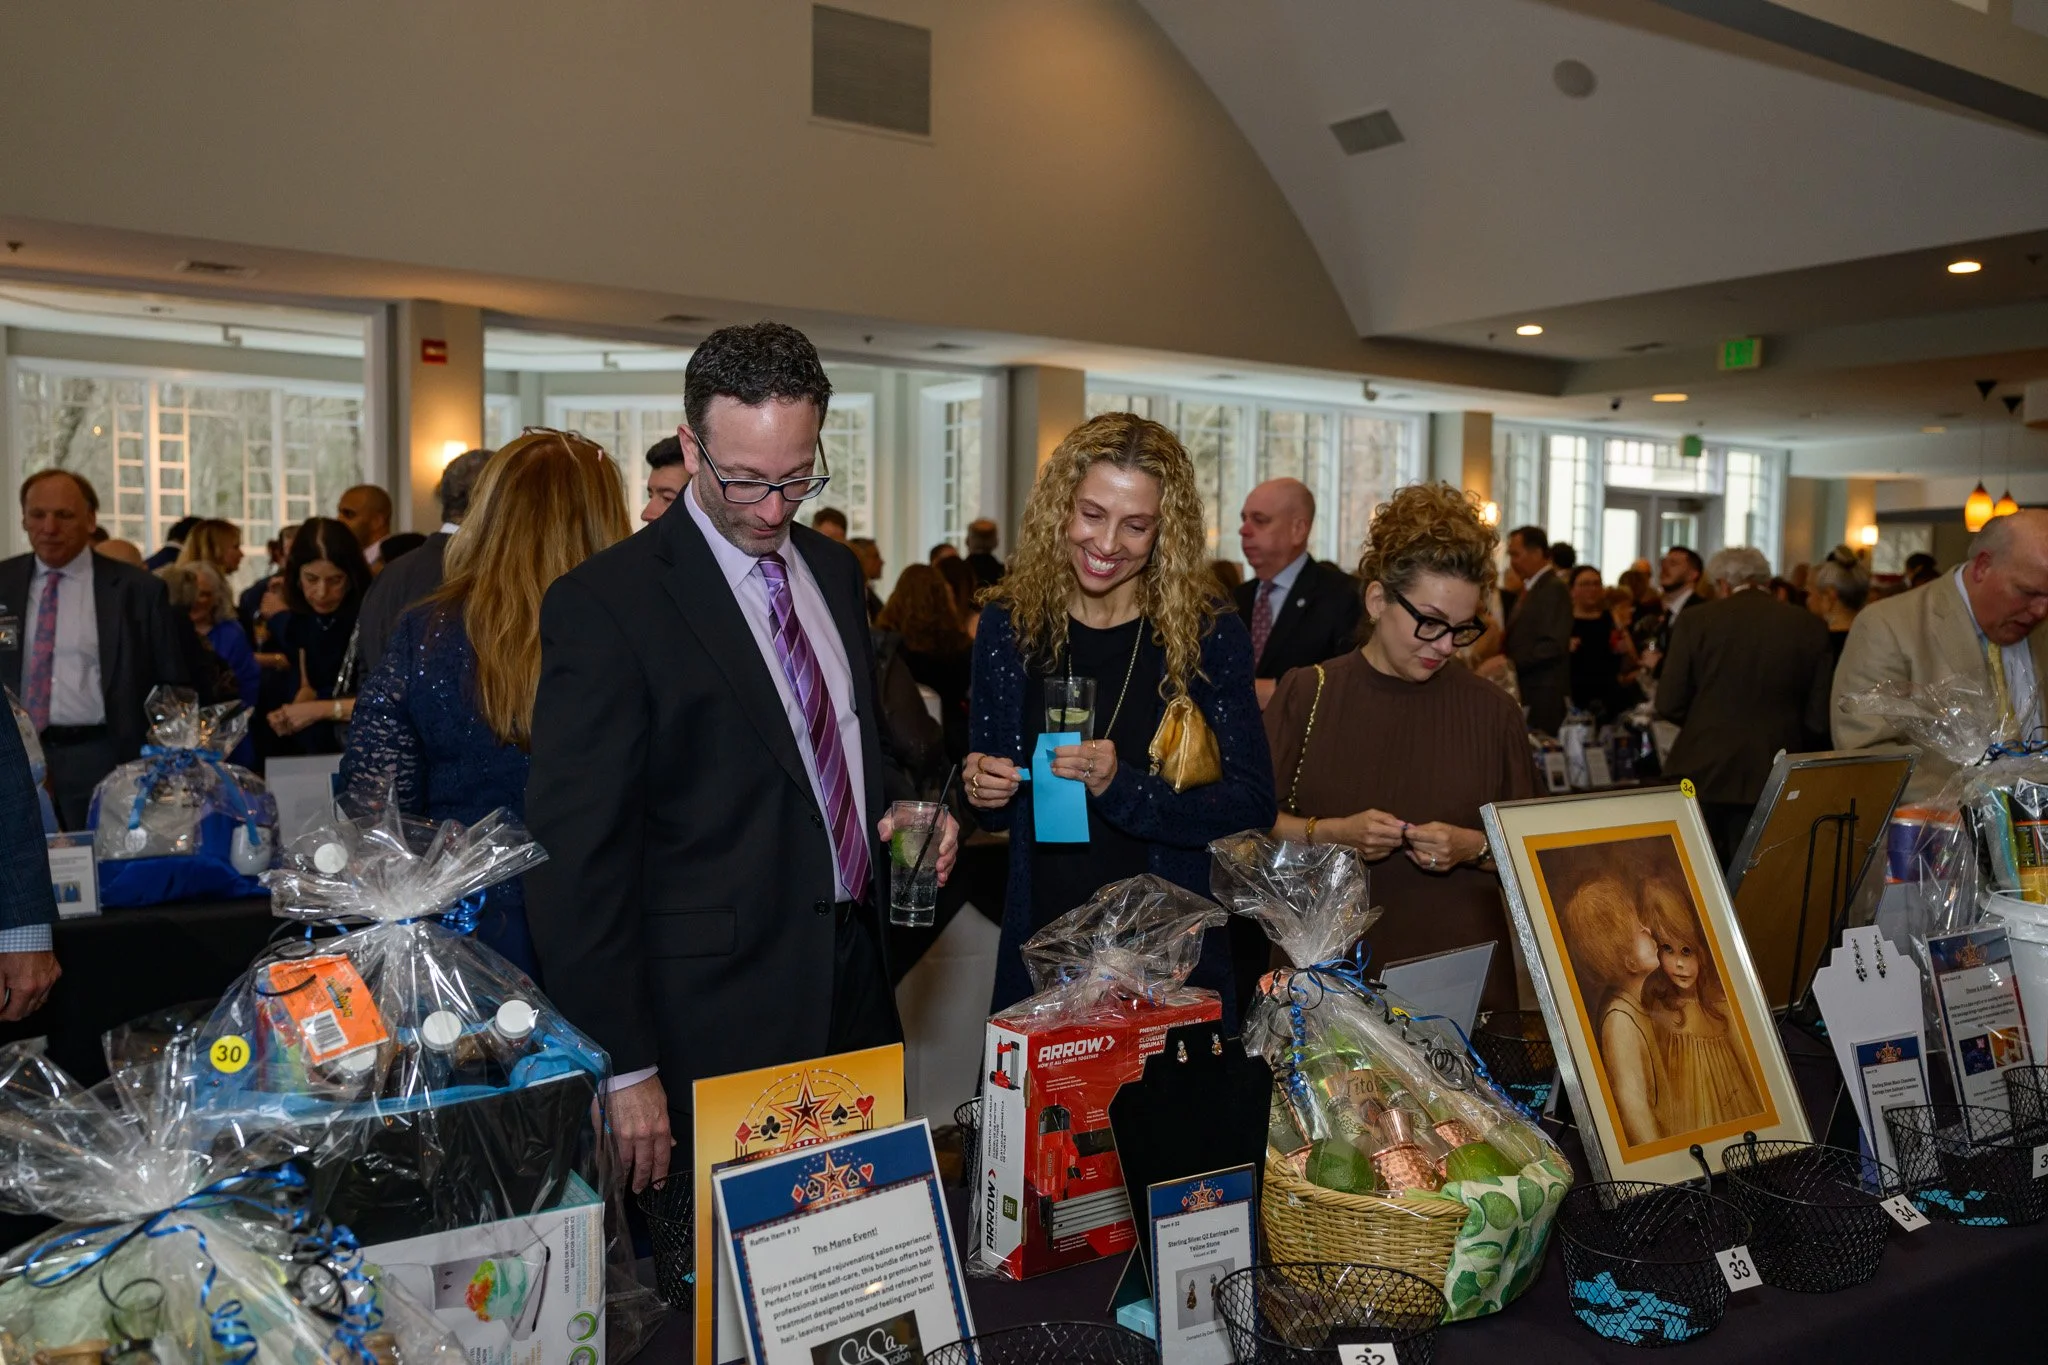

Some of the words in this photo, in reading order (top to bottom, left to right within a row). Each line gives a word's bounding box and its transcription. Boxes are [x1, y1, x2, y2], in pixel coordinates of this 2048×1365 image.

[1683, 782, 1693, 794] 34
[216, 1044, 242, 1063] 30
[1038, 1037, 1104, 1062] ARROW
[1139, 1040, 1165, 1050] PNEUMATI
[2041, 1154, 2048, 1168] 3
[986, 1180, 996, 1250] ARROW
[1896, 1204, 1918, 1222] 34
[750, 1235, 770, 1247] Raffle
[771, 1231, 786, 1240] Item
[793, 1226, 801, 1234] 31
[812, 1244, 828, 1256] The
[829, 1237, 852, 1251] Mane
[852, 1227, 878, 1243] Event!
[1168, 1239, 1187, 1248] Sterling
[1188, 1235, 1201, 1243] Silver
[1209, 1230, 1229, 1238] Earrings
[1190, 1243, 1206, 1252] Yellow
[1206, 1240, 1220, 1248] Stone
[761, 1284, 782, 1296] Enjoy
[788, 1272, 817, 1286] relaxing
[818, 1267, 832, 1276] and
[832, 1252, 875, 1273] rejuvenating
[876, 1246, 894, 1257] salon
[894, 1232, 932, 1250] experience!
[1729, 1260, 1750, 1280] 33
[764, 1294, 792, 1308] Perfect
[792, 1289, 803, 1299] for
[809, 1281, 827, 1293] little
[827, 1270, 861, 1286] self-care,
[861, 1265, 874, 1275] this
[875, 1257, 898, 1271] bundle
[900, 1250, 918, 1262] offers
[919, 1244, 935, 1255] both
[773, 1298, 819, 1320] professional
[819, 1291, 839, 1302] salon
[840, 1281, 868, 1296] services
[869, 1275, 882, 1285] and
[888, 1263, 919, 1280] premium
[919, 1259, 932, 1268] hair
[776, 1314, 813, 1333] treatment
[813, 1301, 846, 1317] designed
[846, 1299, 854, 1307] to
[854, 1289, 881, 1304] nourish
[881, 1284, 894, 1294] and
[895, 1276, 919, 1289] refresh
[919, 1271, 934, 1283] your
[780, 1335, 798, 1345] hair,
[798, 1323, 825, 1338] leaving
[825, 1319, 838, 1330] you
[838, 1308, 865, 1324] looking
[865, 1303, 878, 1314] and
[878, 1295, 903, 1310] feeling
[902, 1290, 917, 1303] your
[918, 1282, 935, 1294] best!
